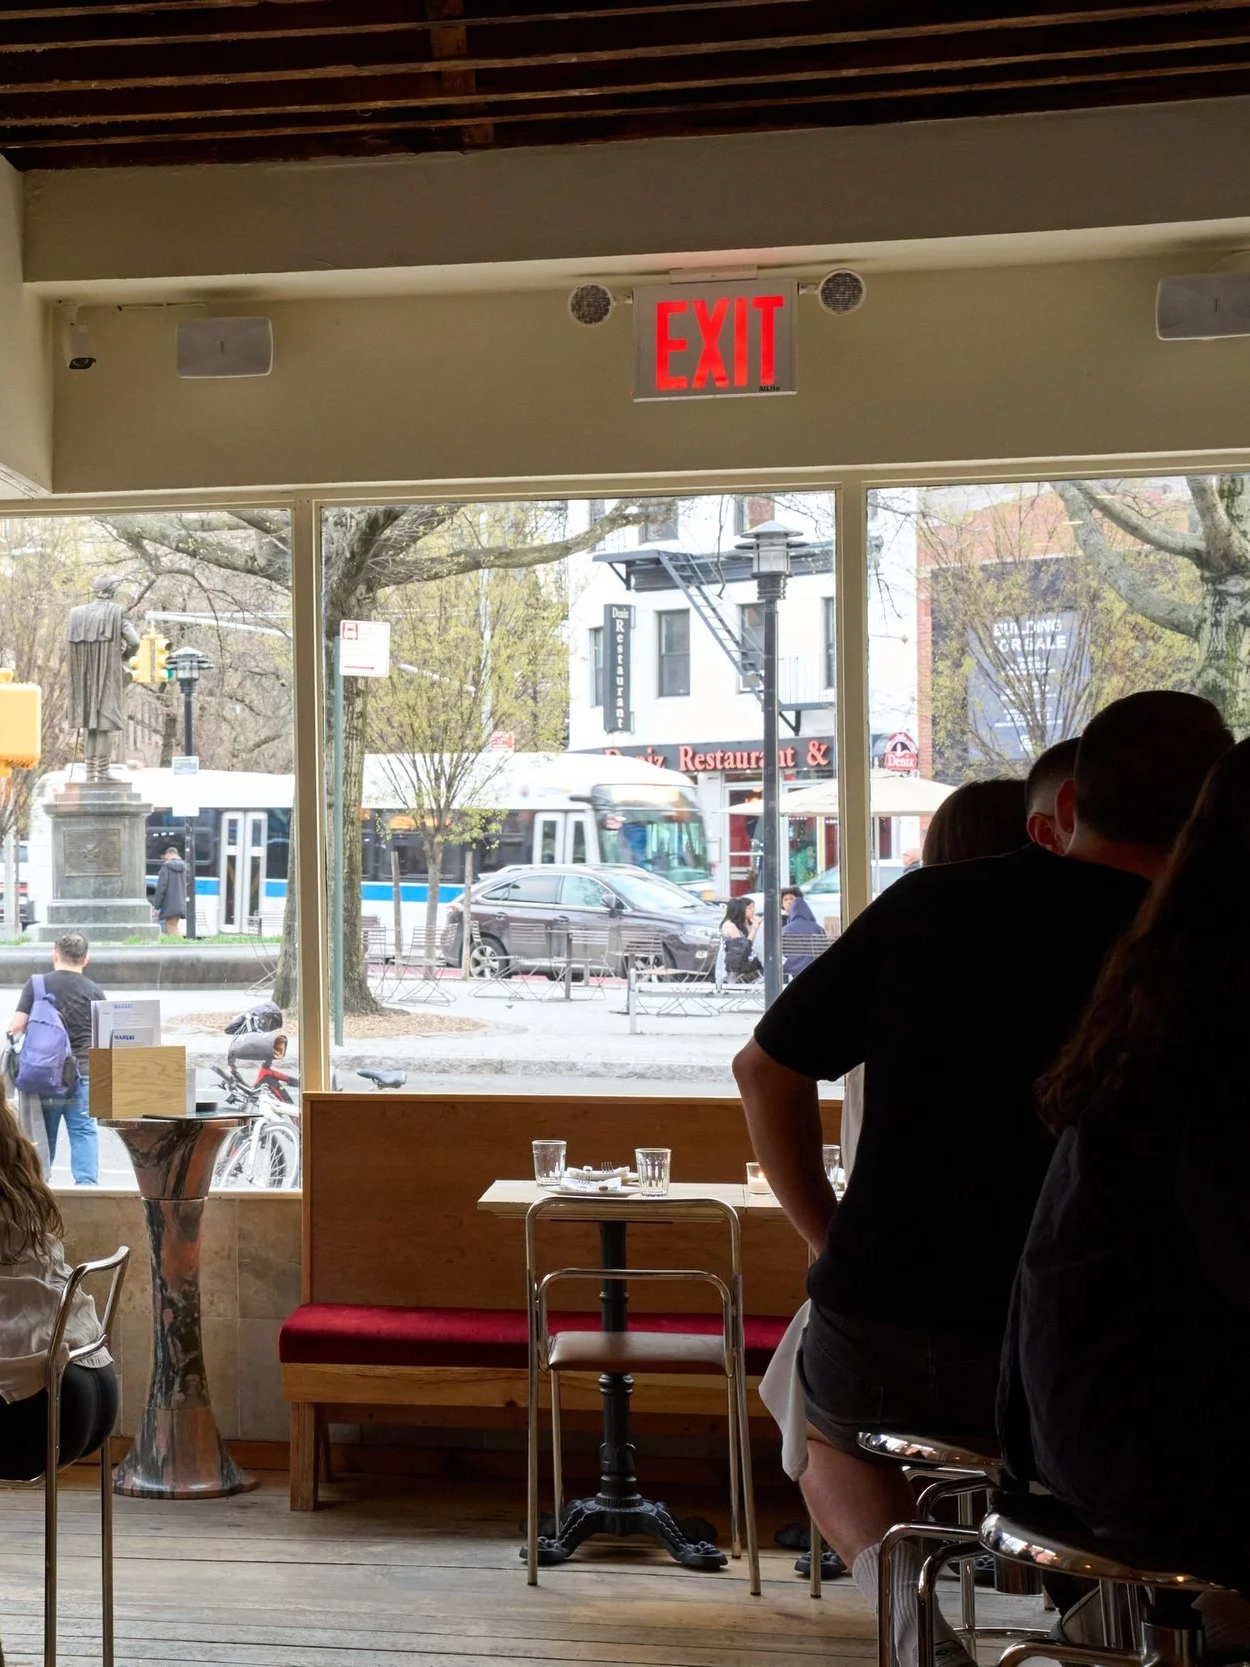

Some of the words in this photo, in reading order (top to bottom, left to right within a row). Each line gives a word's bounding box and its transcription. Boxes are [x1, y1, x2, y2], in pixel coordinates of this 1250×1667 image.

[656, 295, 784, 391] EXIT
[615, 619, 625, 728] Restaurant
[994, 638, 1022, 652] OR
[1024, 635, 1066, 651] SALE
[806, 740, 830, 766] &
